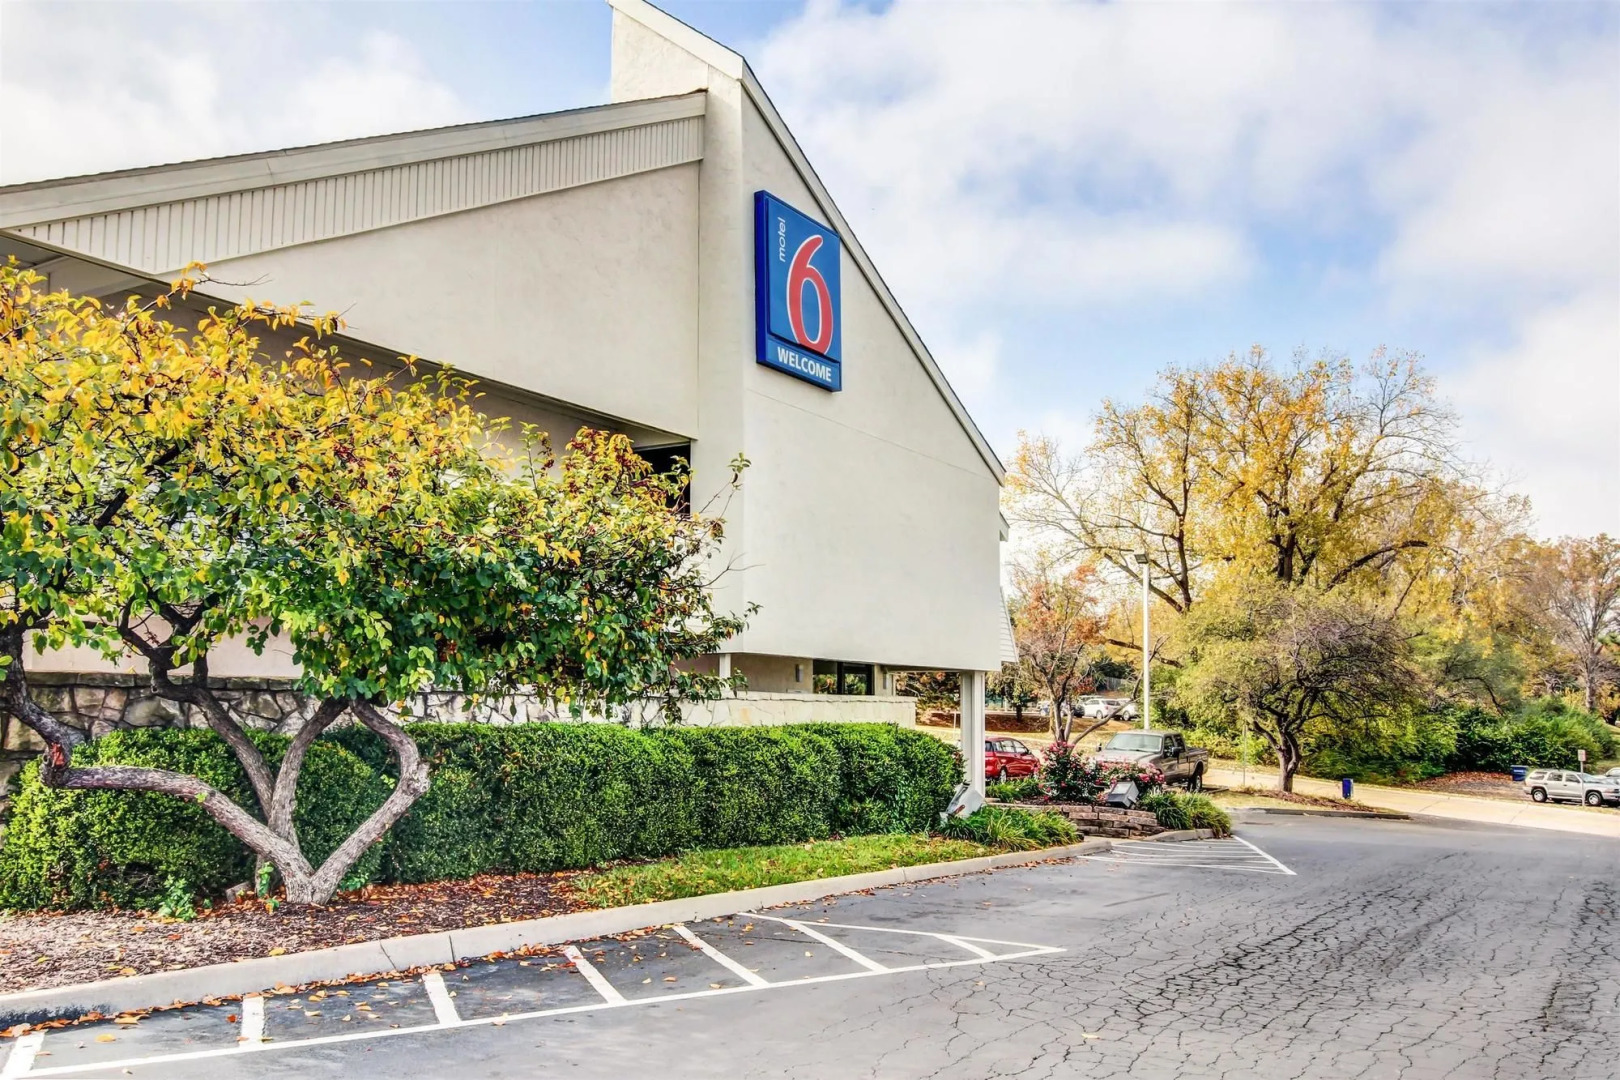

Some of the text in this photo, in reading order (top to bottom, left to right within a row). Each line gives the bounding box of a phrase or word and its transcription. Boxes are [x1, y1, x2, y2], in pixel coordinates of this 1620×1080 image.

[777, 217, 786, 262] motel
[787, 235, 833, 355] 6
[777, 346, 832, 382] WELCOME
